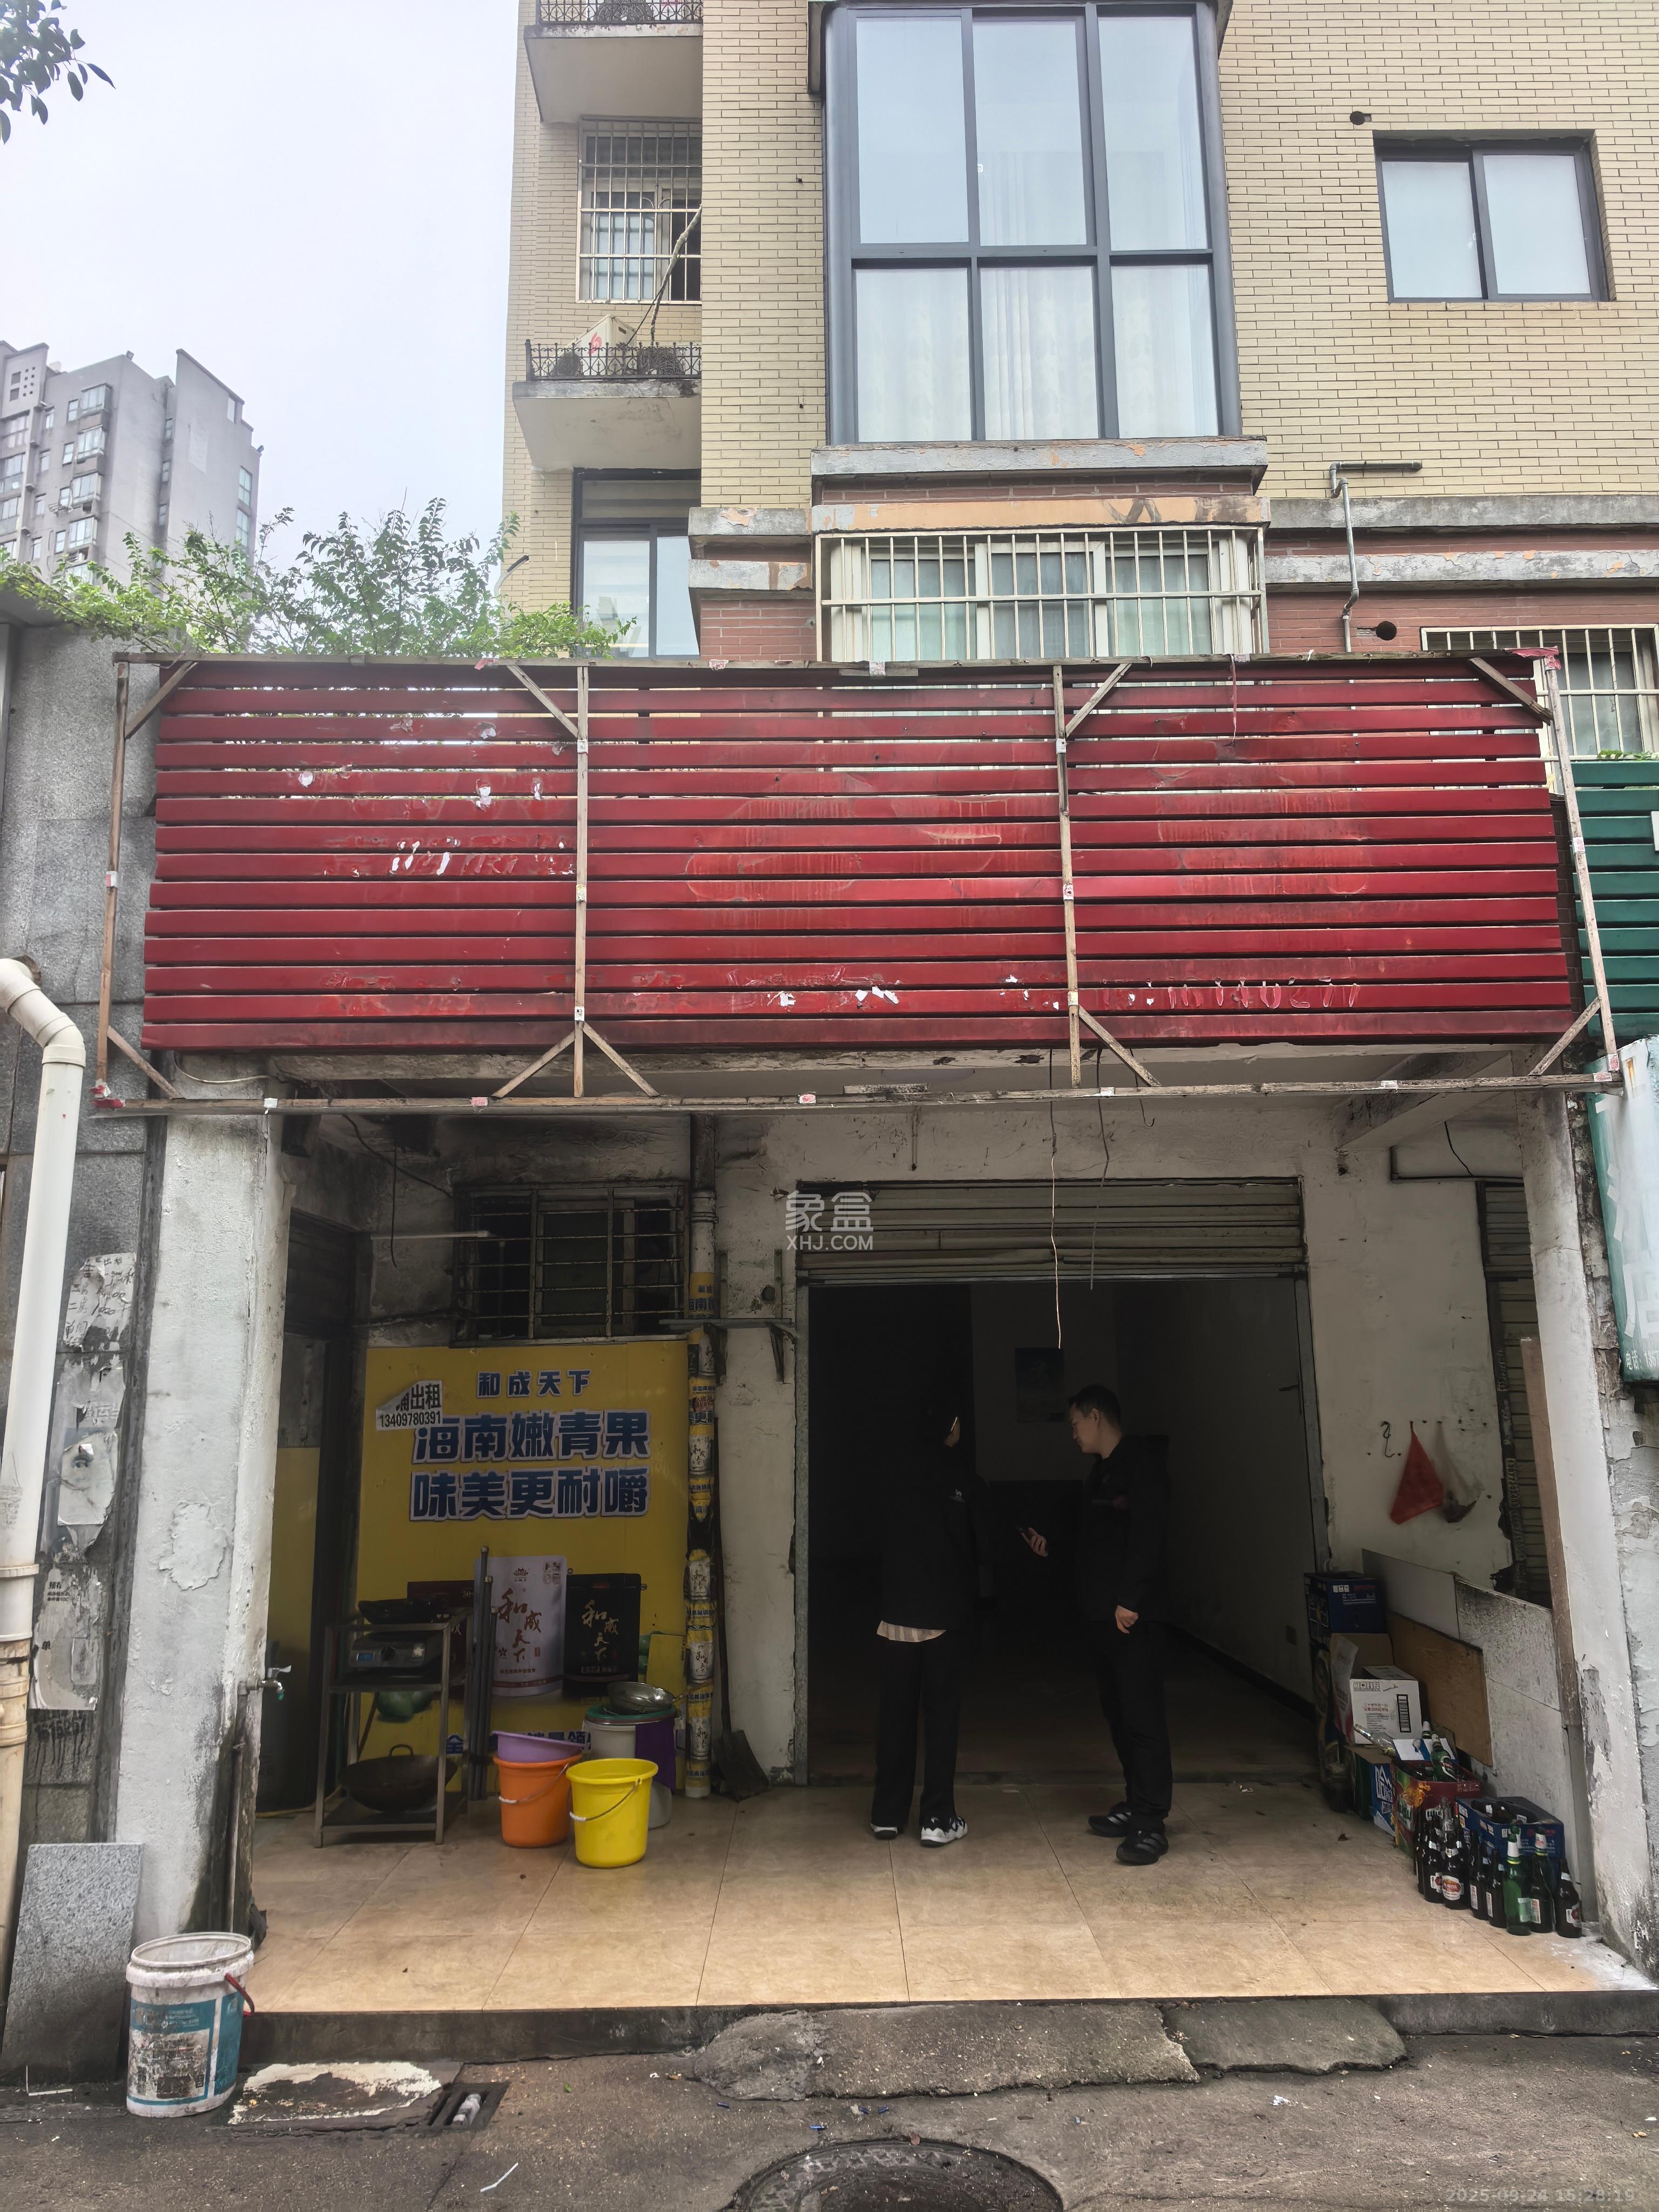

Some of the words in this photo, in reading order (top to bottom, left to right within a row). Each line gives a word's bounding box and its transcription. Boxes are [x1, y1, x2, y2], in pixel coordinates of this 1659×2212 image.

[476, 1369, 592, 1399] 和成天下
[379, 1411, 441, 1428] 13409780391
[413, 1410, 650, 1463] 海南嫩青果
[410, 1466, 650, 1520] 味美更耐嚼
